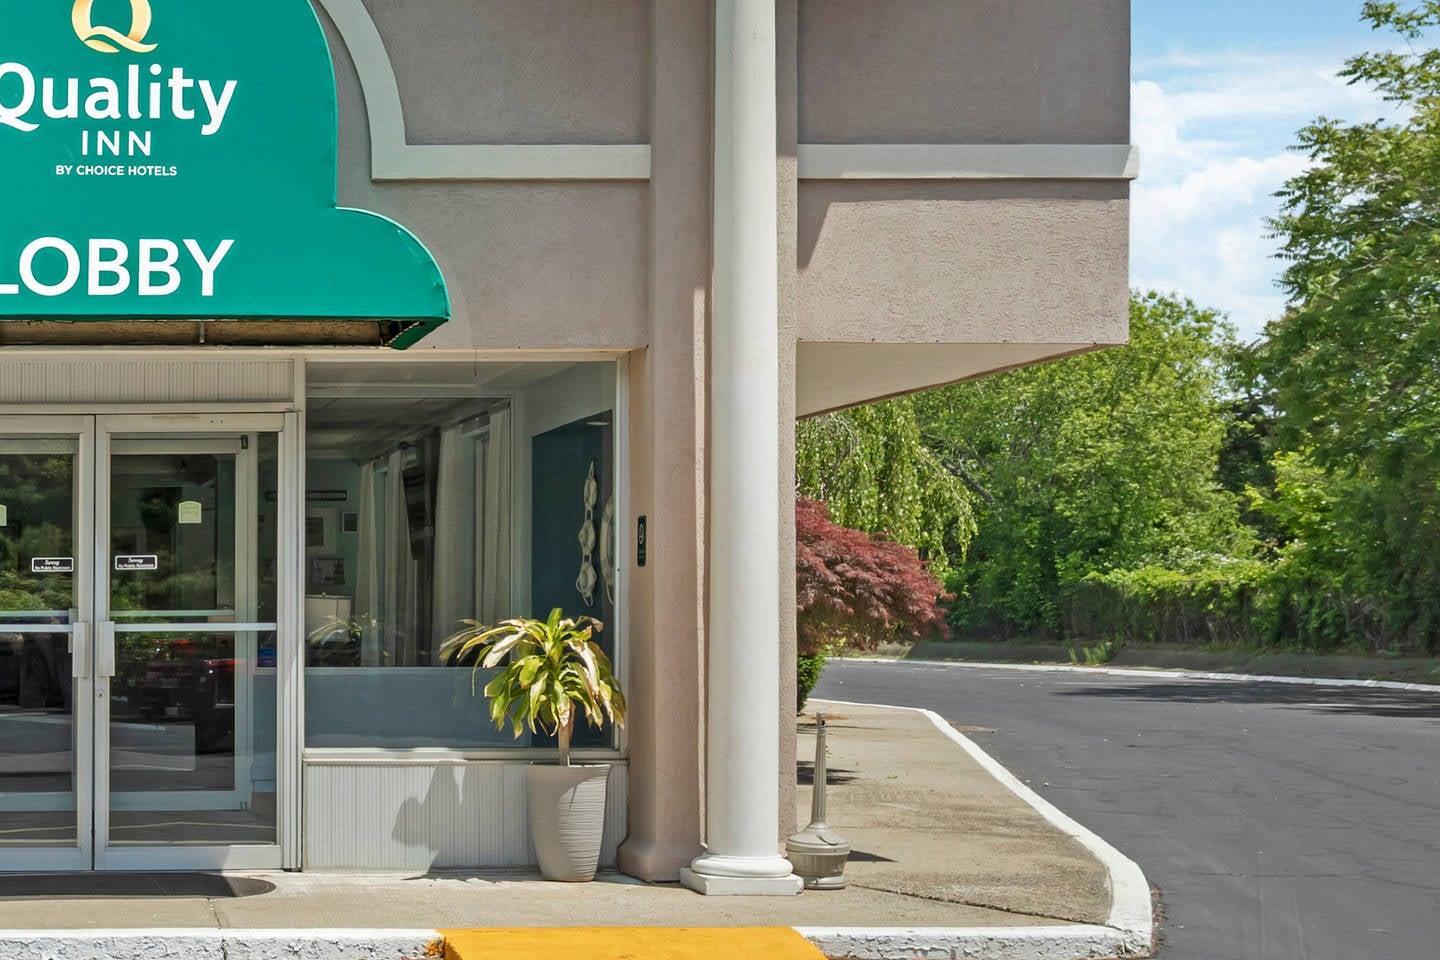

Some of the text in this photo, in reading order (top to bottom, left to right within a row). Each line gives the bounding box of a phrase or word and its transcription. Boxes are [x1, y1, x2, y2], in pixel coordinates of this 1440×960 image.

[81, 130, 152, 156] INN
[55, 164, 178, 177] BY CHOICE HOTELS
